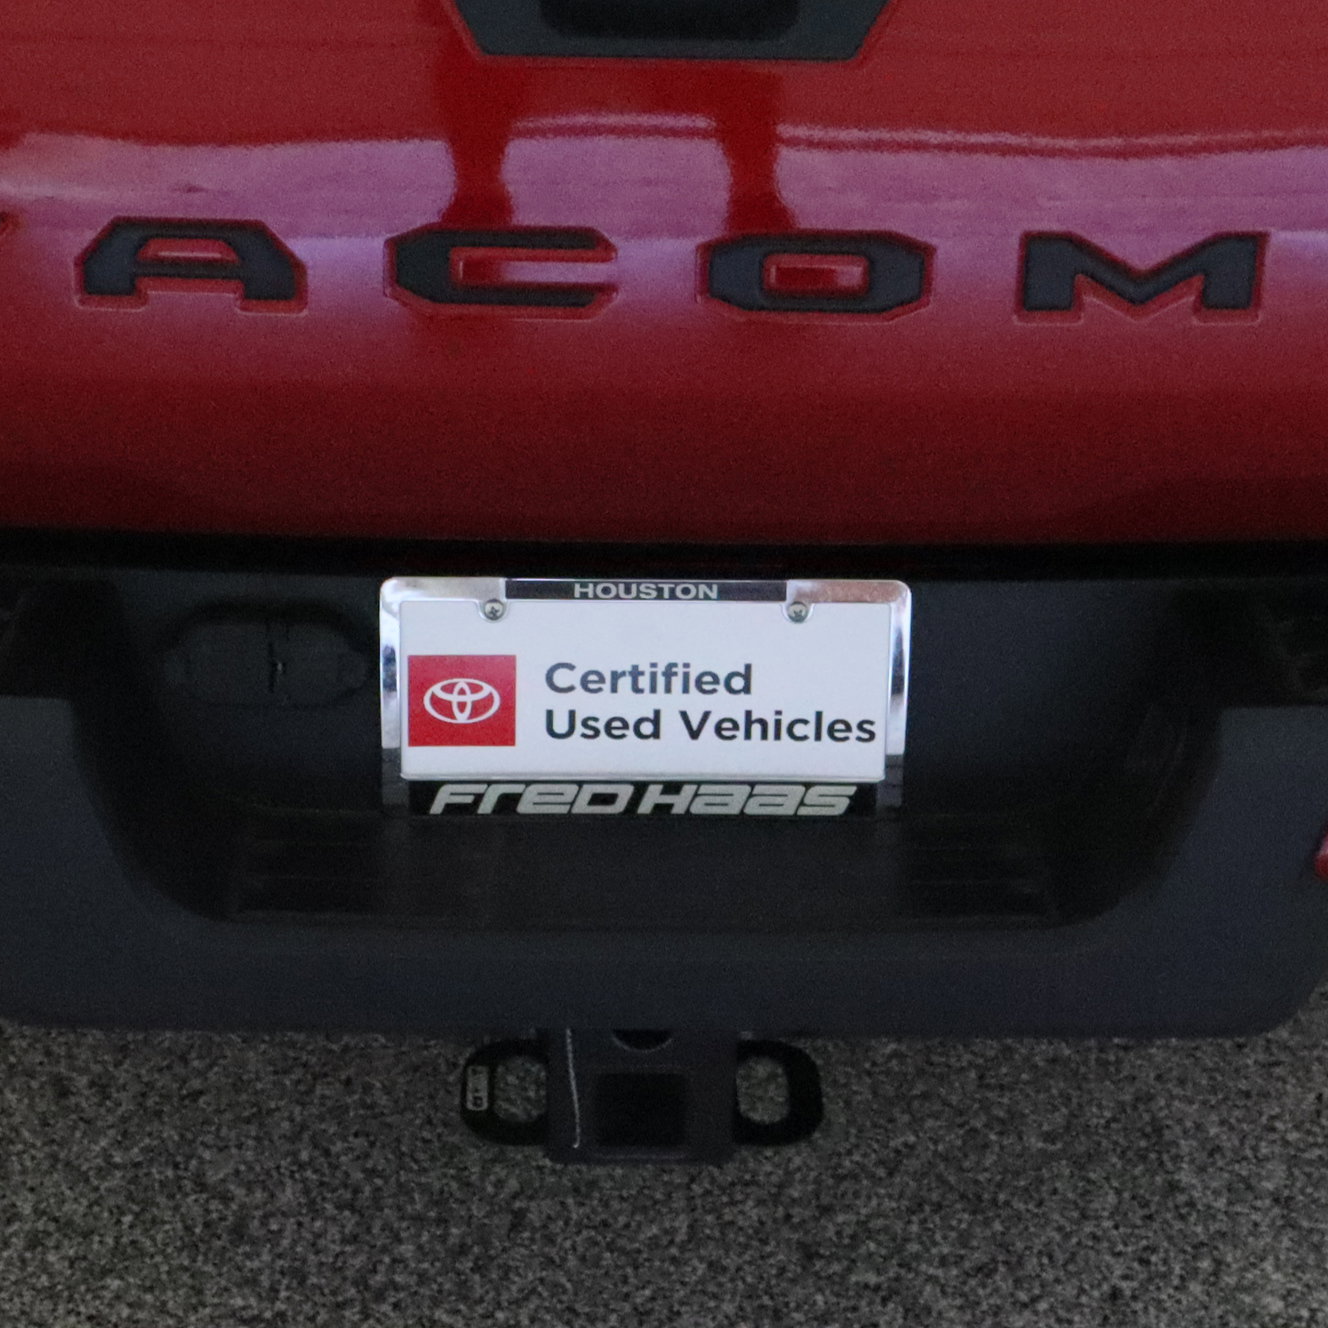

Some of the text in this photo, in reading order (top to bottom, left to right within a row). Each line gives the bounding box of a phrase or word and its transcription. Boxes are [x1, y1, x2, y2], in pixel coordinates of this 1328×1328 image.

[573, 581, 719, 601] HOUSTON
[544, 662, 753, 696] Certified
[544, 708, 876, 743] Used Vehicles
